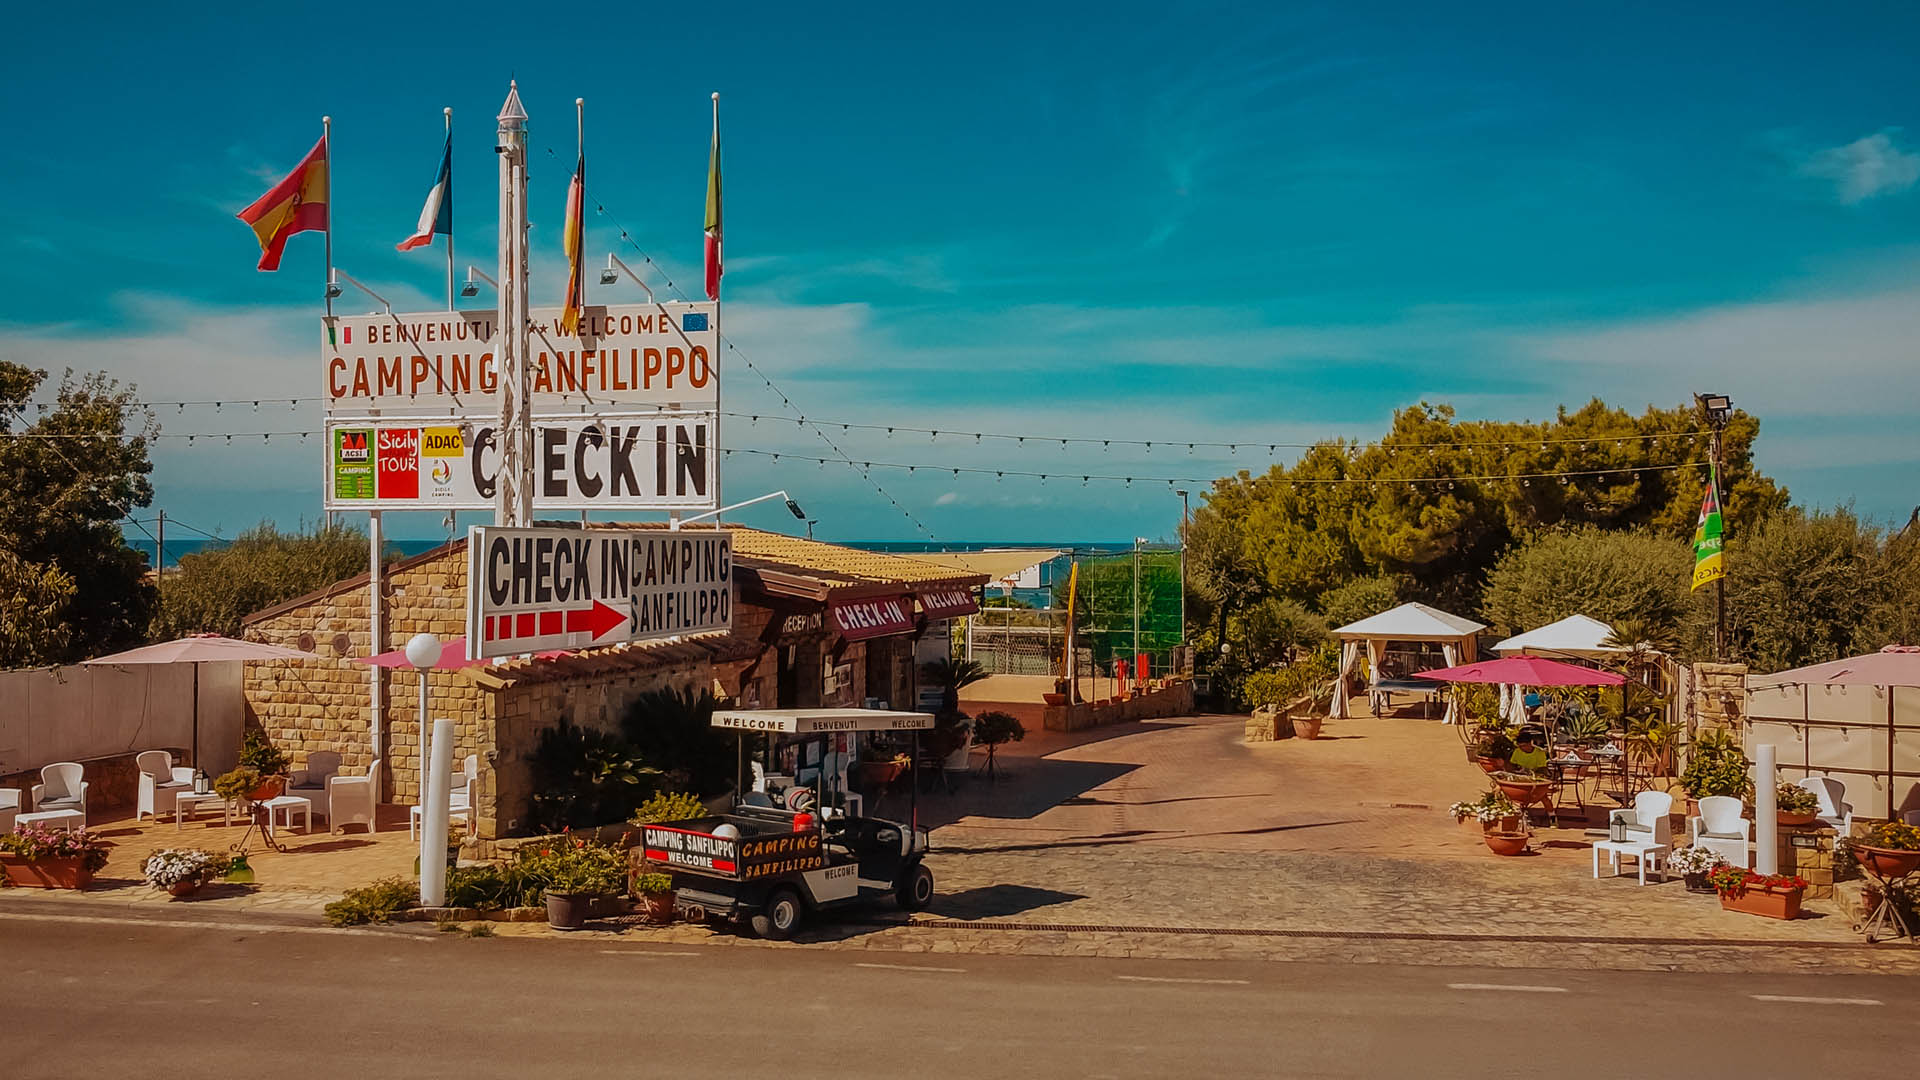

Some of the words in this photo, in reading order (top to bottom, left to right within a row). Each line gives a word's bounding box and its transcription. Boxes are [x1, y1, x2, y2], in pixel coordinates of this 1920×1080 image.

[367, 321, 490, 344] BENVENUTI
[554, 313, 669, 338] WELCOME
[329, 352, 498, 398] CAMPING
[534, 345, 709, 393] ANFILIPPO
[378, 430, 418, 457] Sicily
[425, 435, 460, 449] ADAC
[378, 457, 418, 472] TOUR
[656, 424, 706, 497] IN
[488, 536, 592, 606] CHECK
[601, 538, 629, 599] IN
[631, 538, 729, 588] CAMPING
[631, 588, 728, 634] SANFILIPPO
[783, 612, 822, 633] RECEPTION
[834, 600, 906, 631] CHECK-IN
[723, 717, 785, 730] WELCOME
[812, 720, 858, 730] BENVENUTI
[891, 719, 926, 729] WELCOME
[646, 829, 683, 850] CAMPING
[686, 835, 735, 859] SANFILIPPO
[742, 835, 819, 858] CAMPING
[668, 851, 713, 868] WELCOME
[745, 856, 822, 879] SANFILIPPO
[824, 866, 856, 880] WELCOME
